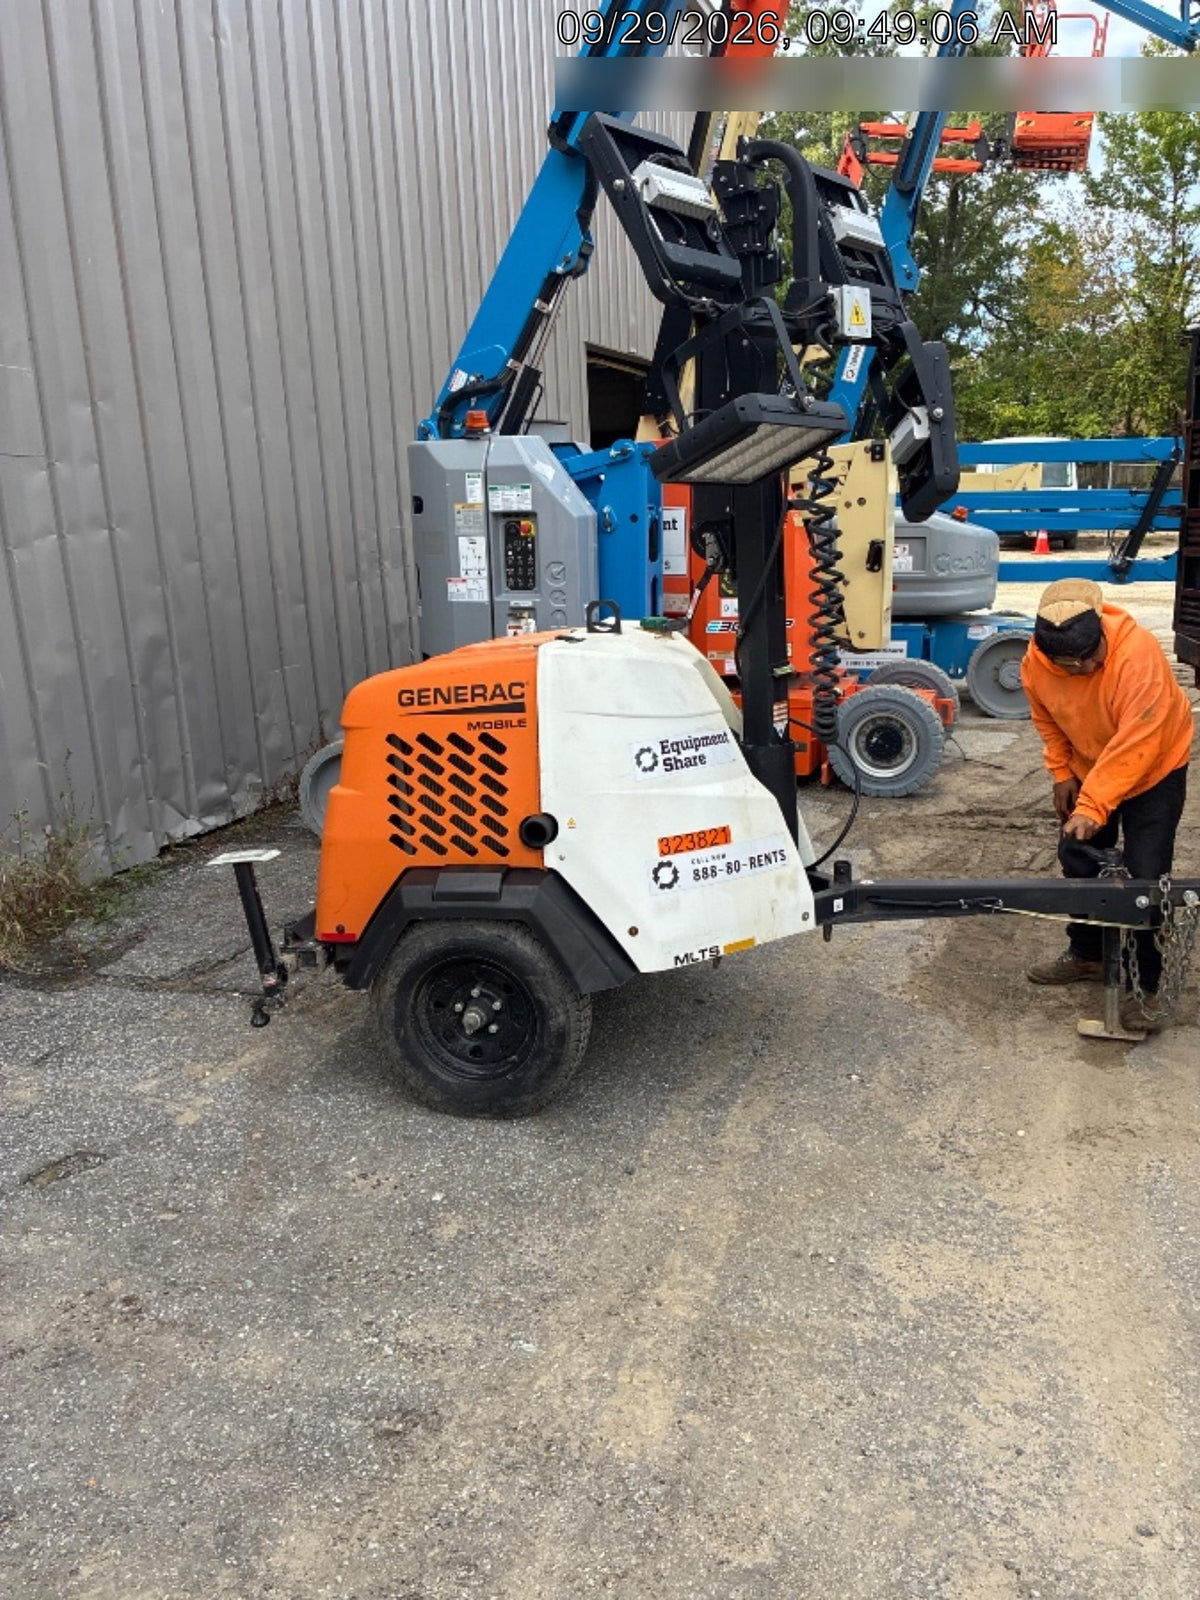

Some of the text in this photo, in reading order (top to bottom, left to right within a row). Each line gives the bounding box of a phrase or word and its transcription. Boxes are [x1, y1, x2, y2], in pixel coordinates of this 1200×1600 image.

[397, 682, 525, 707] GENERAC
[467, 718, 527, 731] MOBILE
[659, 731, 730, 755] Equipment
[662, 753, 707, 772] Share
[660, 827, 730, 856] 323821
[693, 849, 788, 882] 888-80-RENTS
[673, 945, 721, 966] MLTS
